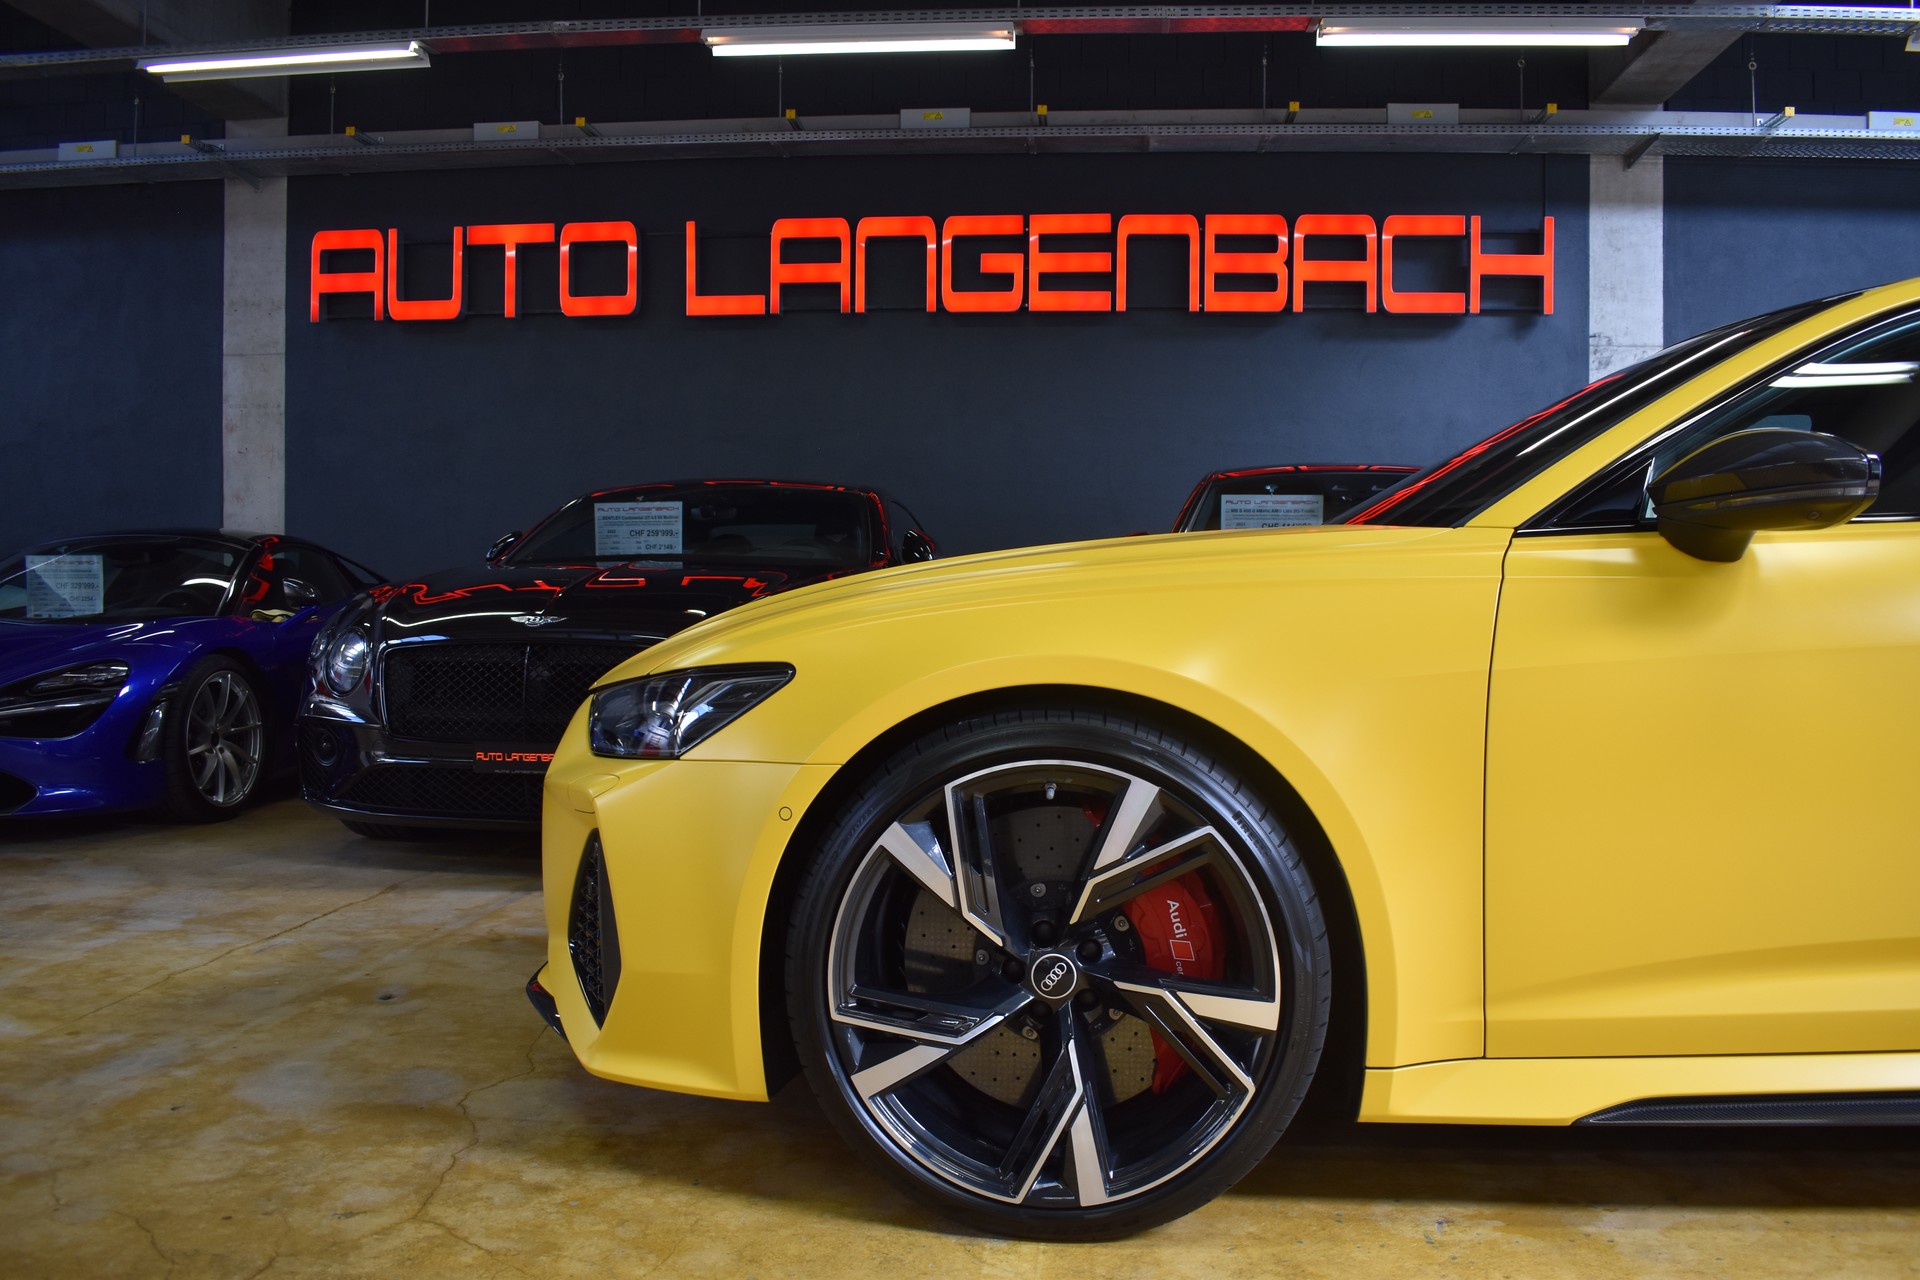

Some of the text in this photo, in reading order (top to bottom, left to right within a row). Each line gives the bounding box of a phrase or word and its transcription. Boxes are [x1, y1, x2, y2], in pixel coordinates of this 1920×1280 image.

[310, 213, 1555, 322] AUTO LANGENBACH
[629, 529, 679, 537] CHF 259'999.-
[475, 752, 555, 762] AUTO LANGENBA
[1166, 899, 1188, 939] Audi
[1175, 961, 1184, 976] cer
